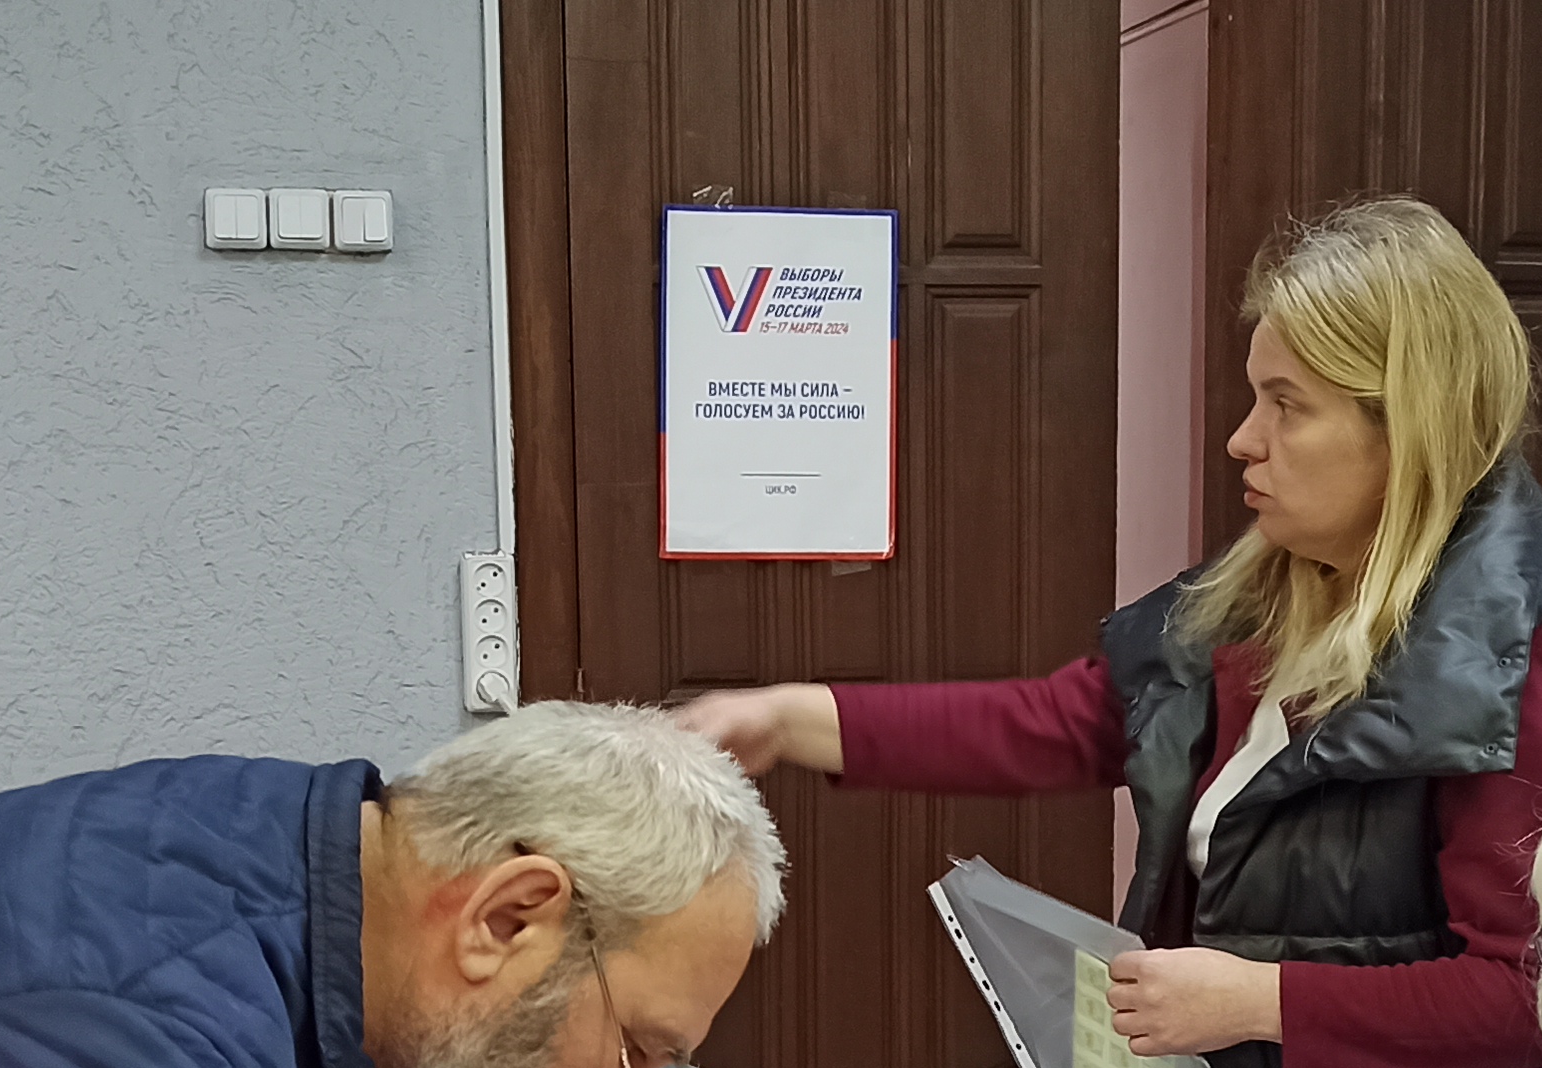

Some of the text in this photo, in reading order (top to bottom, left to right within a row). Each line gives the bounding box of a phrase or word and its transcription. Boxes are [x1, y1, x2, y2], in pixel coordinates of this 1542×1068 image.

[779, 267, 844, 282] ВЫБОРЫ
[772, 286, 863, 302] ПРЕЗИДЕНТА
[764, 304, 823, 318] РОССИИ
[788, 322, 823, 334] МАРТА
[824, 323, 849, 335] 2024
[708, 381, 766, 397] ВМЕСТЕ
[770, 382, 796, 397] МЫ
[800, 382, 839, 398] СИЛА
[694, 403, 865, 420] ГОЛОСУЕМ ЗА РОССИЮ!
